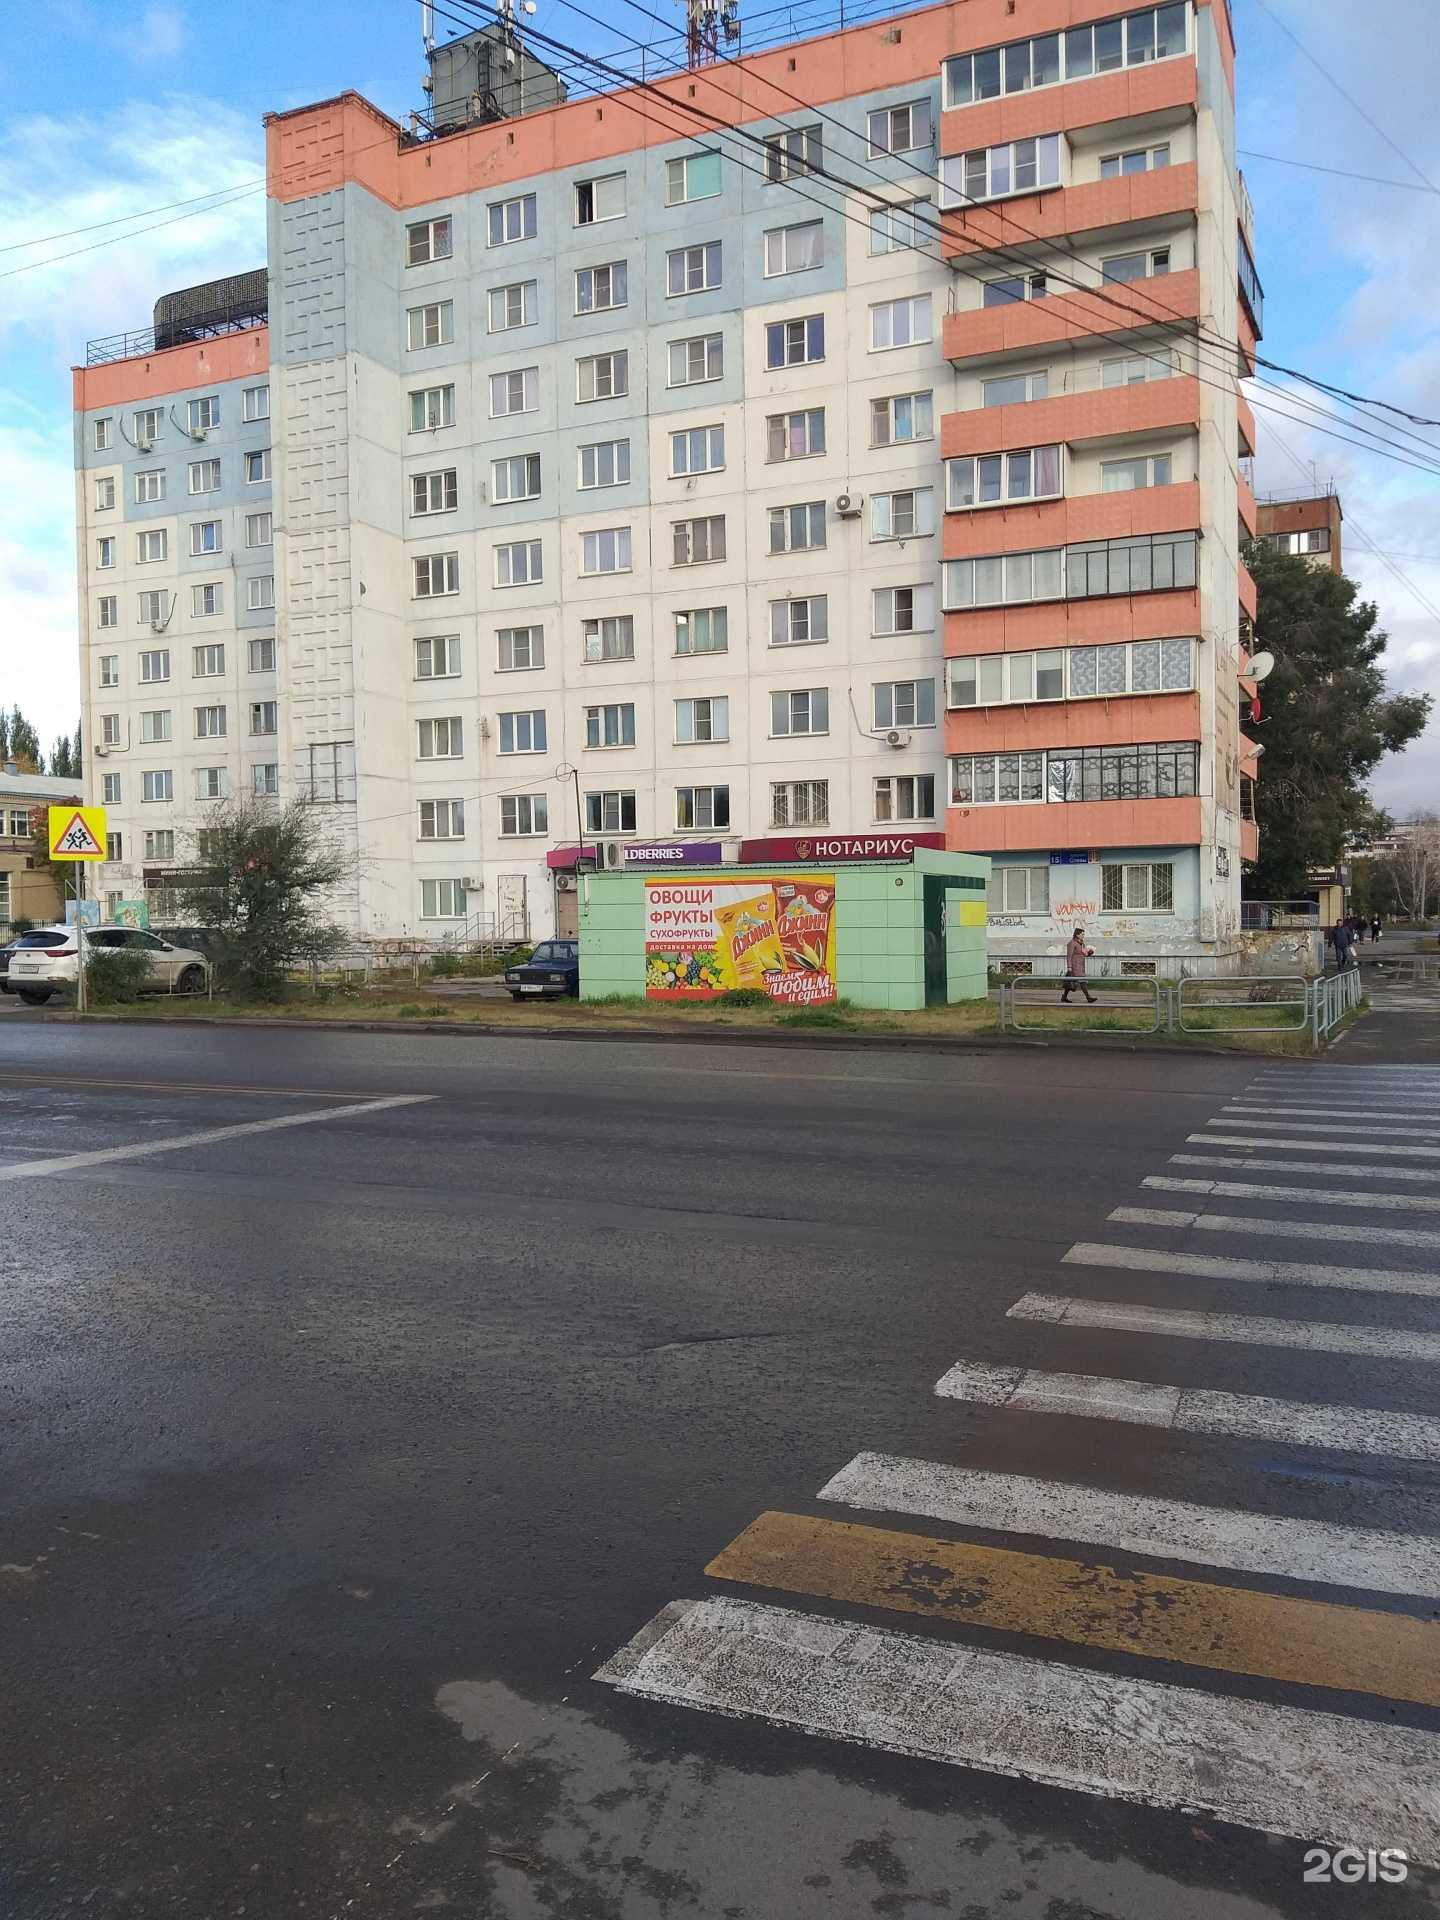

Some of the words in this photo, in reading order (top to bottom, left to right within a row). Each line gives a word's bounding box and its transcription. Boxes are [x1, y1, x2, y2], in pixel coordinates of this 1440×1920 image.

[624, 848, 684, 860] LDBERRIES
[815, 839, 914, 856] НОТАРИУС
[649, 889, 713, 906] ОВОЩИ
[649, 910, 713, 926] ФРУКТЫ
[650, 928, 713, 939] СУХОФРУКТЫ
[649, 943, 686, 951] доставка
[686, 943, 696, 951] на
[767, 971, 830, 996] любим
[788, 993, 796, 1002] и
[797, 984, 834, 1006] едим!
